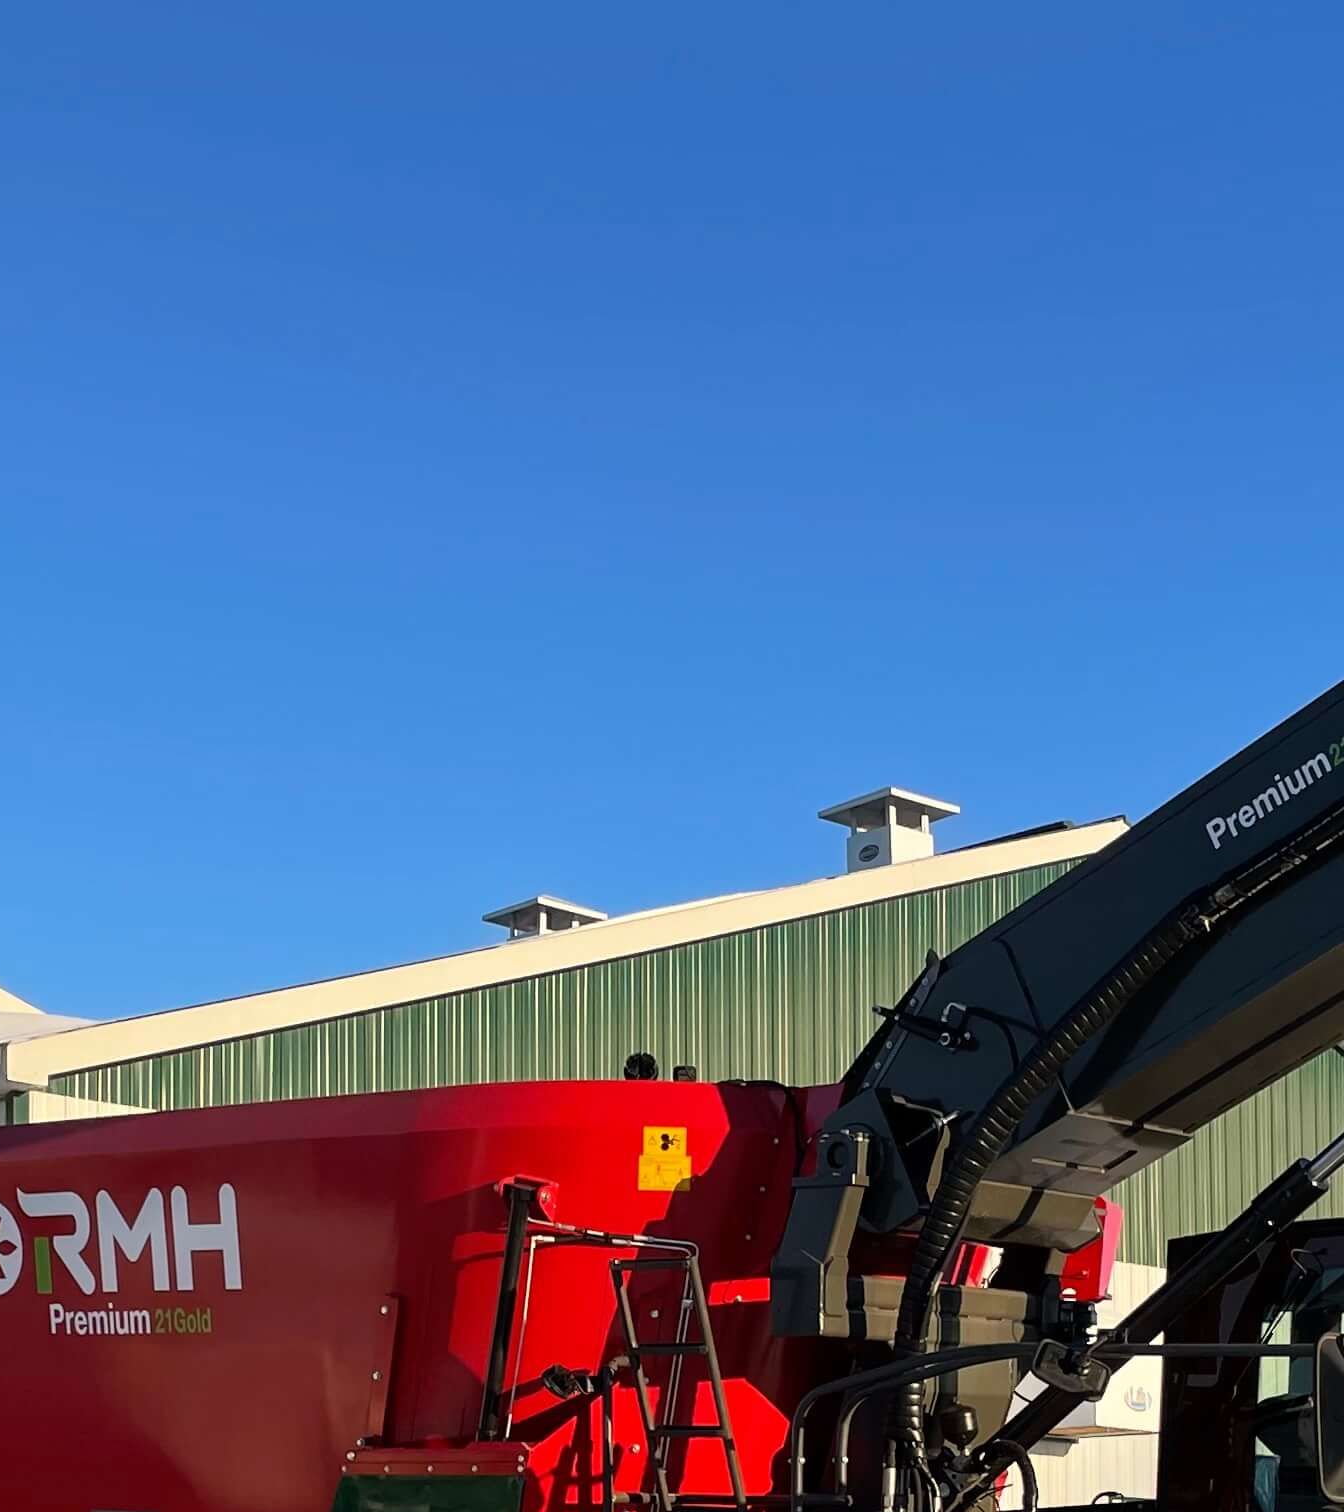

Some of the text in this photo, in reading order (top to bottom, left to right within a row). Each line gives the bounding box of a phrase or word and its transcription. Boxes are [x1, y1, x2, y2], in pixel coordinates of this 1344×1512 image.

[1205, 752, 1333, 849] Premium
[49, 1302, 212, 1335] Premium 21Gold
